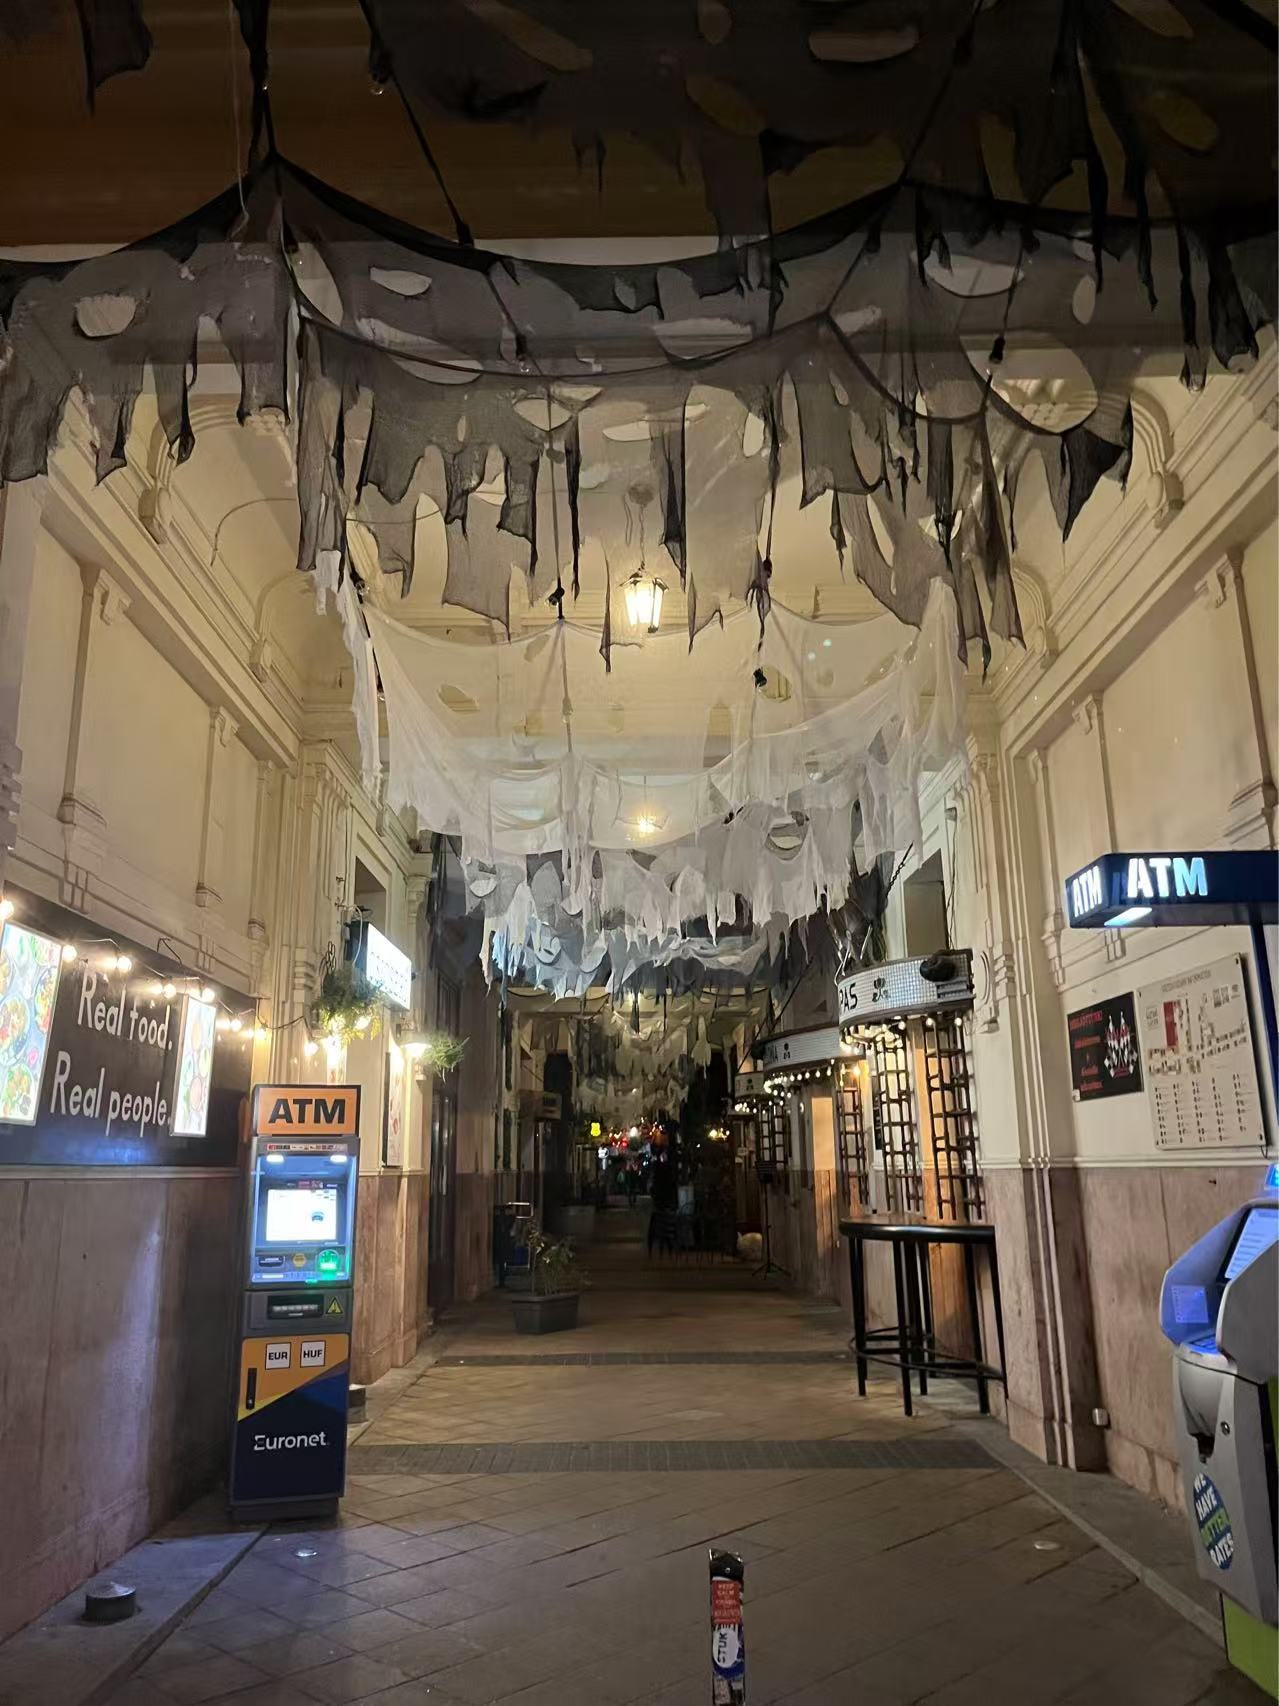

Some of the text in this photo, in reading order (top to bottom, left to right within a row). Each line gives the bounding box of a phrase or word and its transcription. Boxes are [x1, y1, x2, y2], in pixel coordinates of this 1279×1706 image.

[1071, 865, 1103, 918] ATM
[1127, 857, 1209, 898] ATM
[77, 966, 173, 1051] Real food.
[50, 1050, 171, 1138] Real people.
[268, 1098, 345, 1125] ATM
[268, 1349, 323, 1361] EUR HUF
[253, 1431, 327, 1451] Euronet
[1195, 1486, 1217, 1521] HAVE
[1209, 1532, 1234, 1568] RATES
